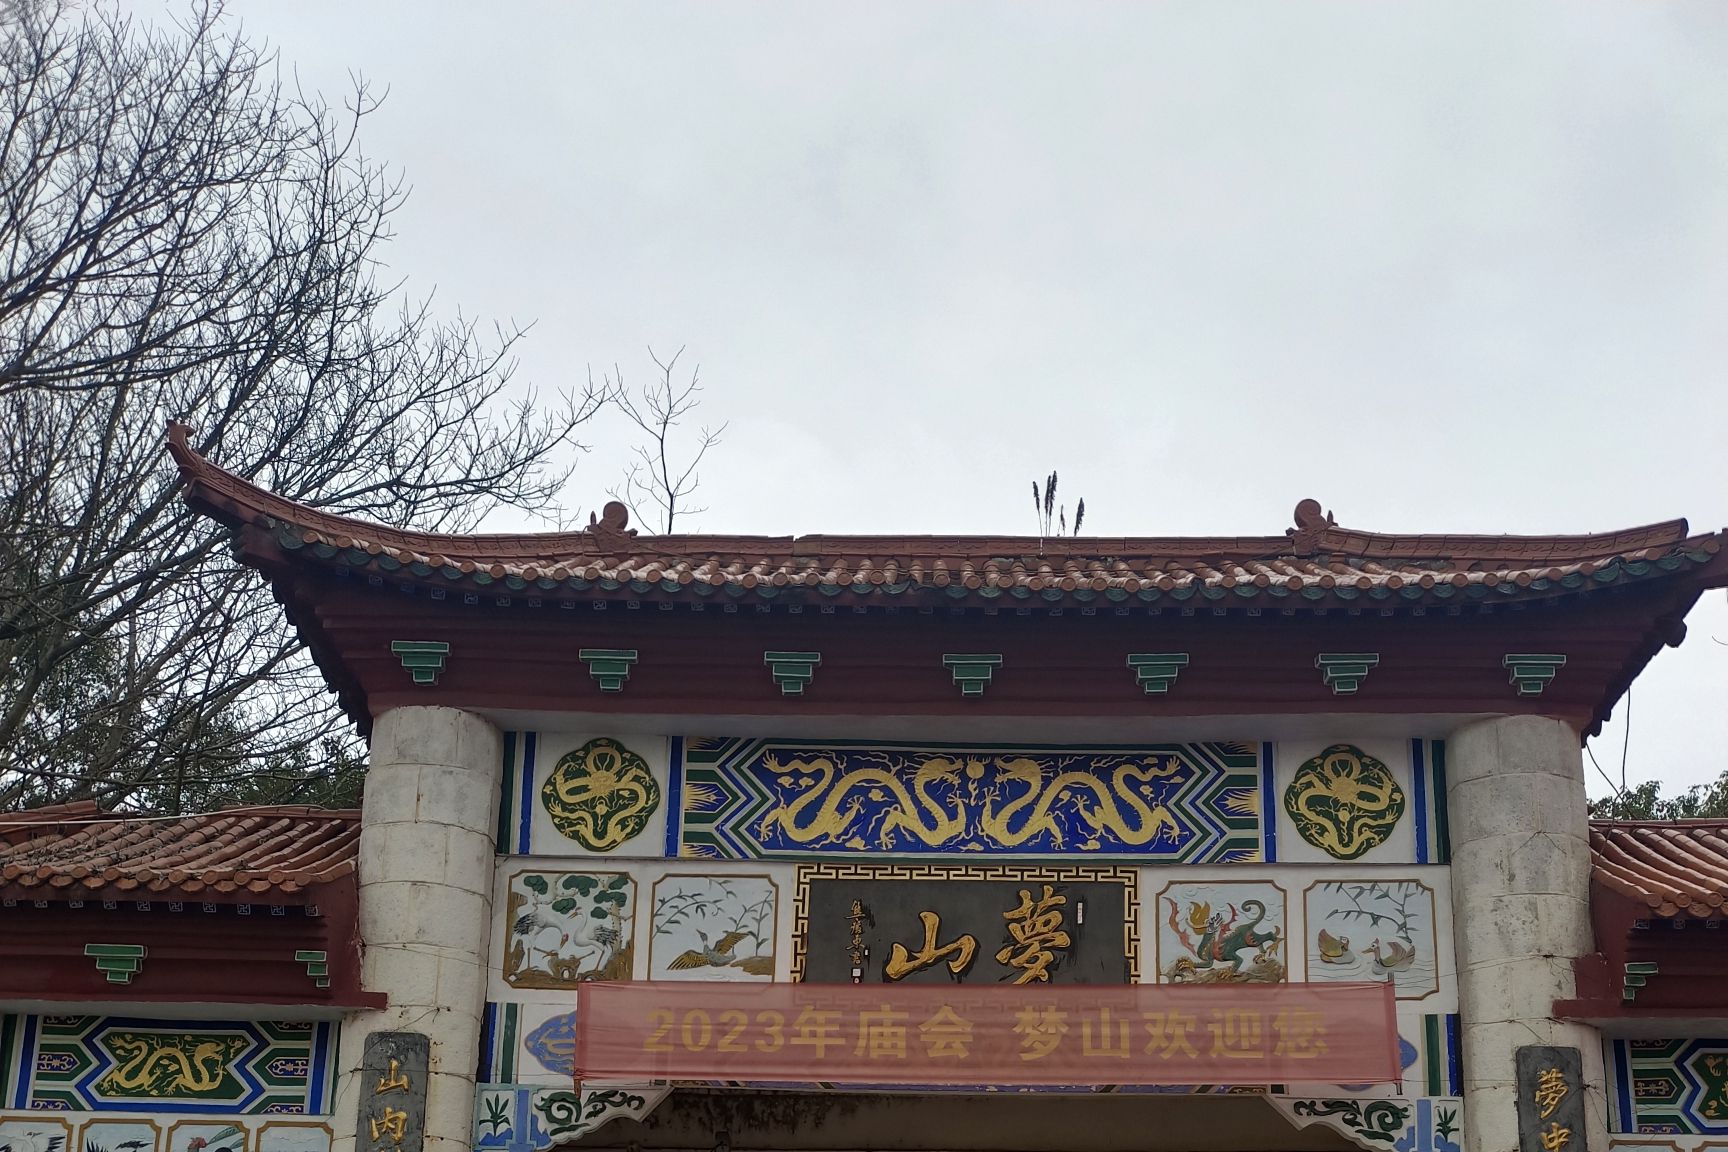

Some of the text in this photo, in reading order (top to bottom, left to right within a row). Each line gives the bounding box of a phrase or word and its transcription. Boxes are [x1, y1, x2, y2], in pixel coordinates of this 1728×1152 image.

[643, 1003, 1330, 1059] 2023年庙会 梦山欢迎您
